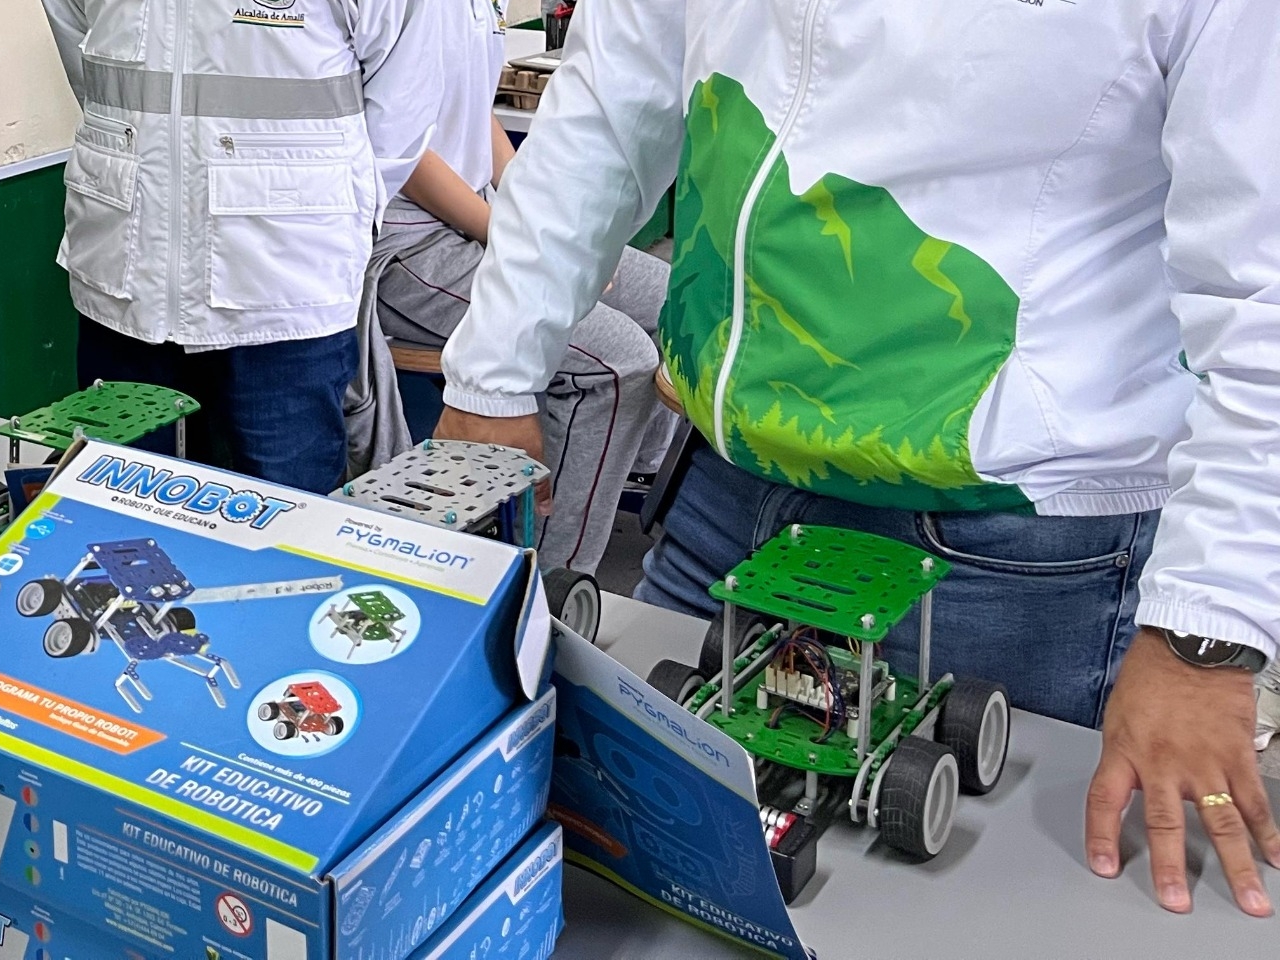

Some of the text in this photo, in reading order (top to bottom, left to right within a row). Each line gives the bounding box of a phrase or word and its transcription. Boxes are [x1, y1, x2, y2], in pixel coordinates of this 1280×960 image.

[234, 8, 304, 21] Alcaldía de Amalfi
[76, 454, 297, 530] INNOBOT
[117, 497, 209, 528] ROBOTS QUE EDUCAN
[344, 518, 383, 532] Powered by
[39, 697, 54, 708] TU
[53, 702, 96, 725] PROPIO
[94, 718, 138, 740] ROBOT!
[179, 755, 323, 817] KIT EDUCATIVO
[237, 752, 352, 799] Contiene más de 400 piezas
[145, 768, 284, 831] DE ROBÓTICA
[122, 822, 142, 838] KIT
[144, 830, 211, 870] EDUCATIVO
[213, 859, 231, 878] DE
[661, 889, 682, 908] DE
[670, 884, 792, 947] KIT EDUCATIVO
